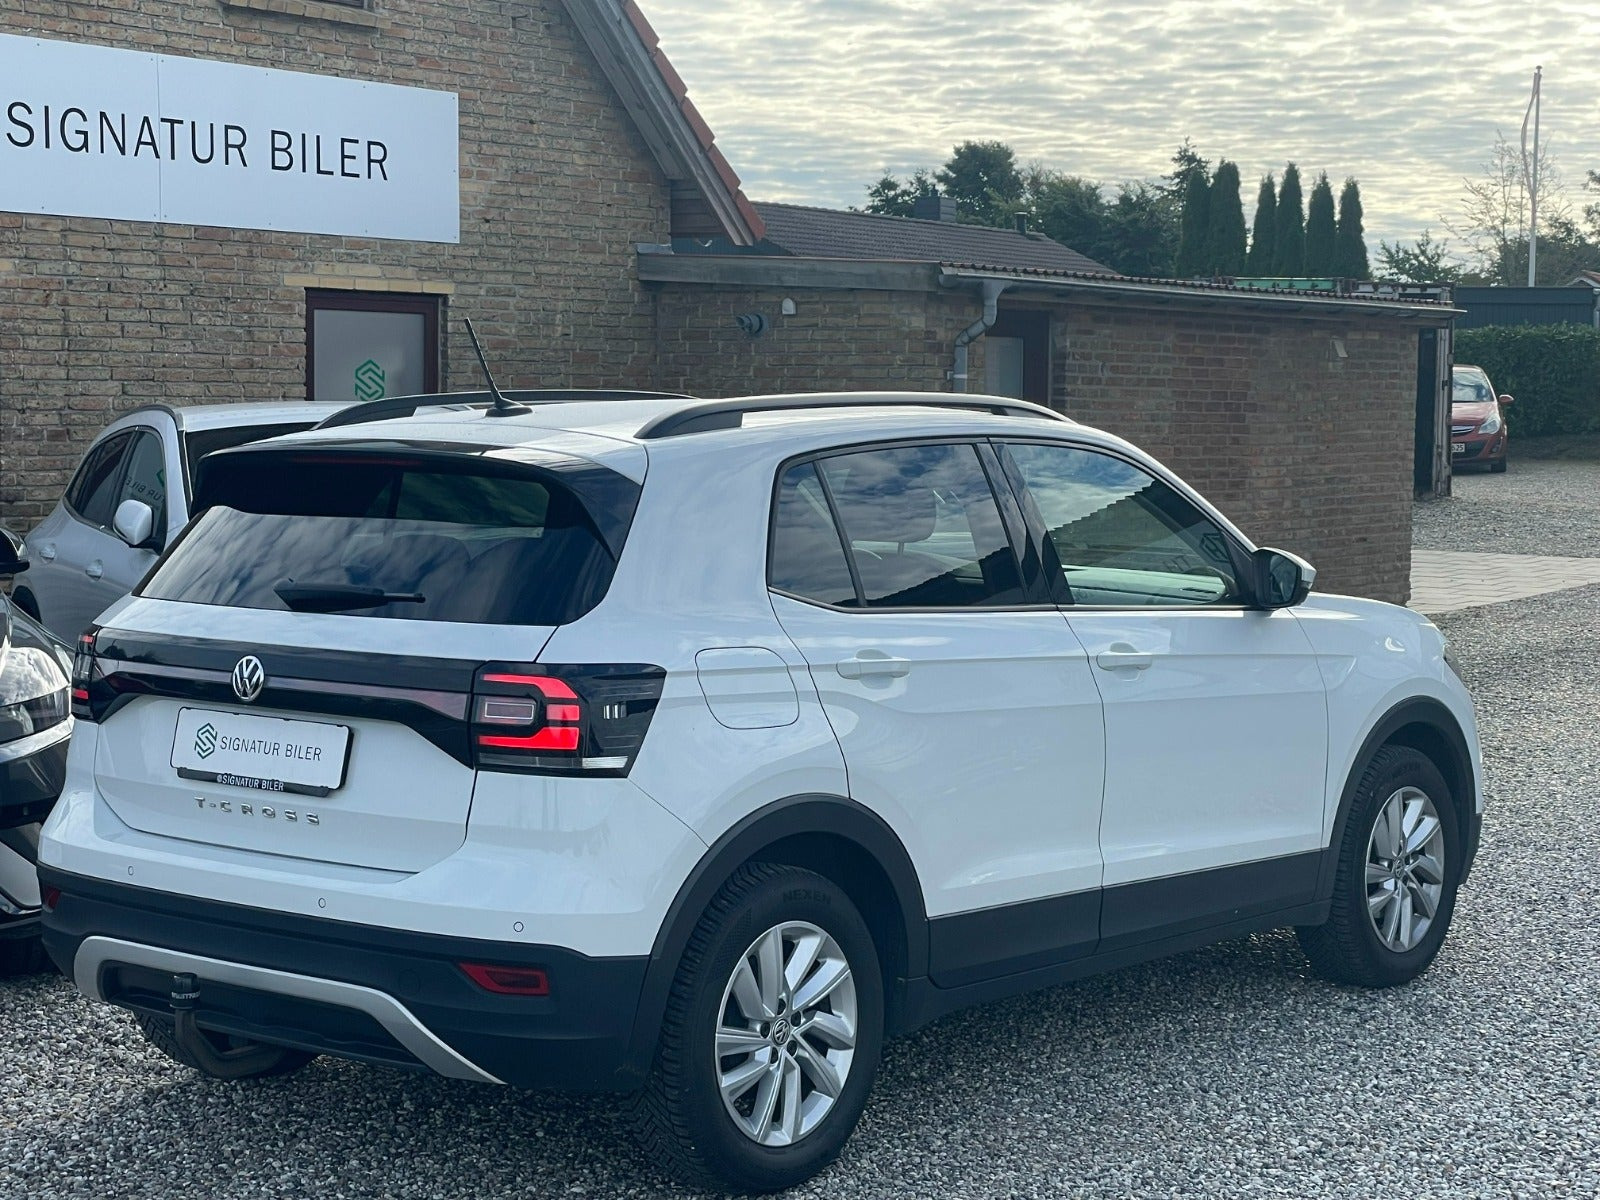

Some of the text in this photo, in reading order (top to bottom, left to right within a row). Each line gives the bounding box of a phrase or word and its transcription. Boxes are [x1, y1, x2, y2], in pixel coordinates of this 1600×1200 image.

[6, 101, 388, 181] SIGNATUR BILER
[220, 736, 322, 761] SIGNATUR BILER
[261, 780, 284, 791] BILER
[194, 796, 320, 826] T-CROSS
